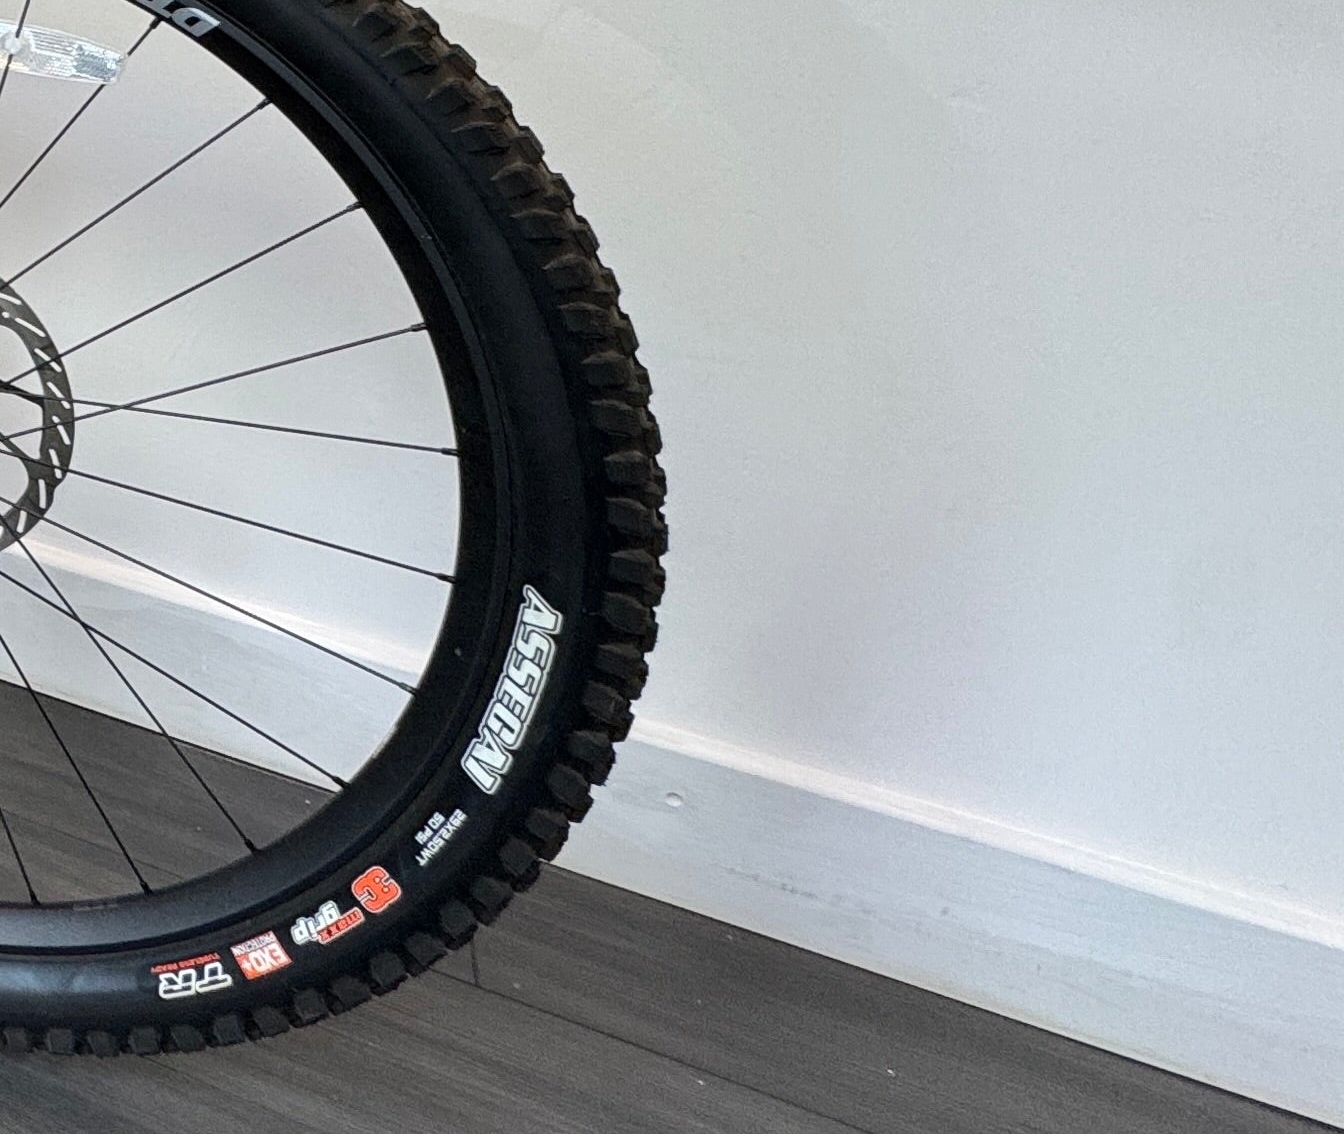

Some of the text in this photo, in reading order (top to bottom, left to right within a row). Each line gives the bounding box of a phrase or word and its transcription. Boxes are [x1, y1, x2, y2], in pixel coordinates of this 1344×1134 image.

[460, 584, 565, 795] ASSEGAI
[414, 824, 434, 845] PSI
[290, 900, 341, 946] grip
[158, 961, 233, 1000] TR
